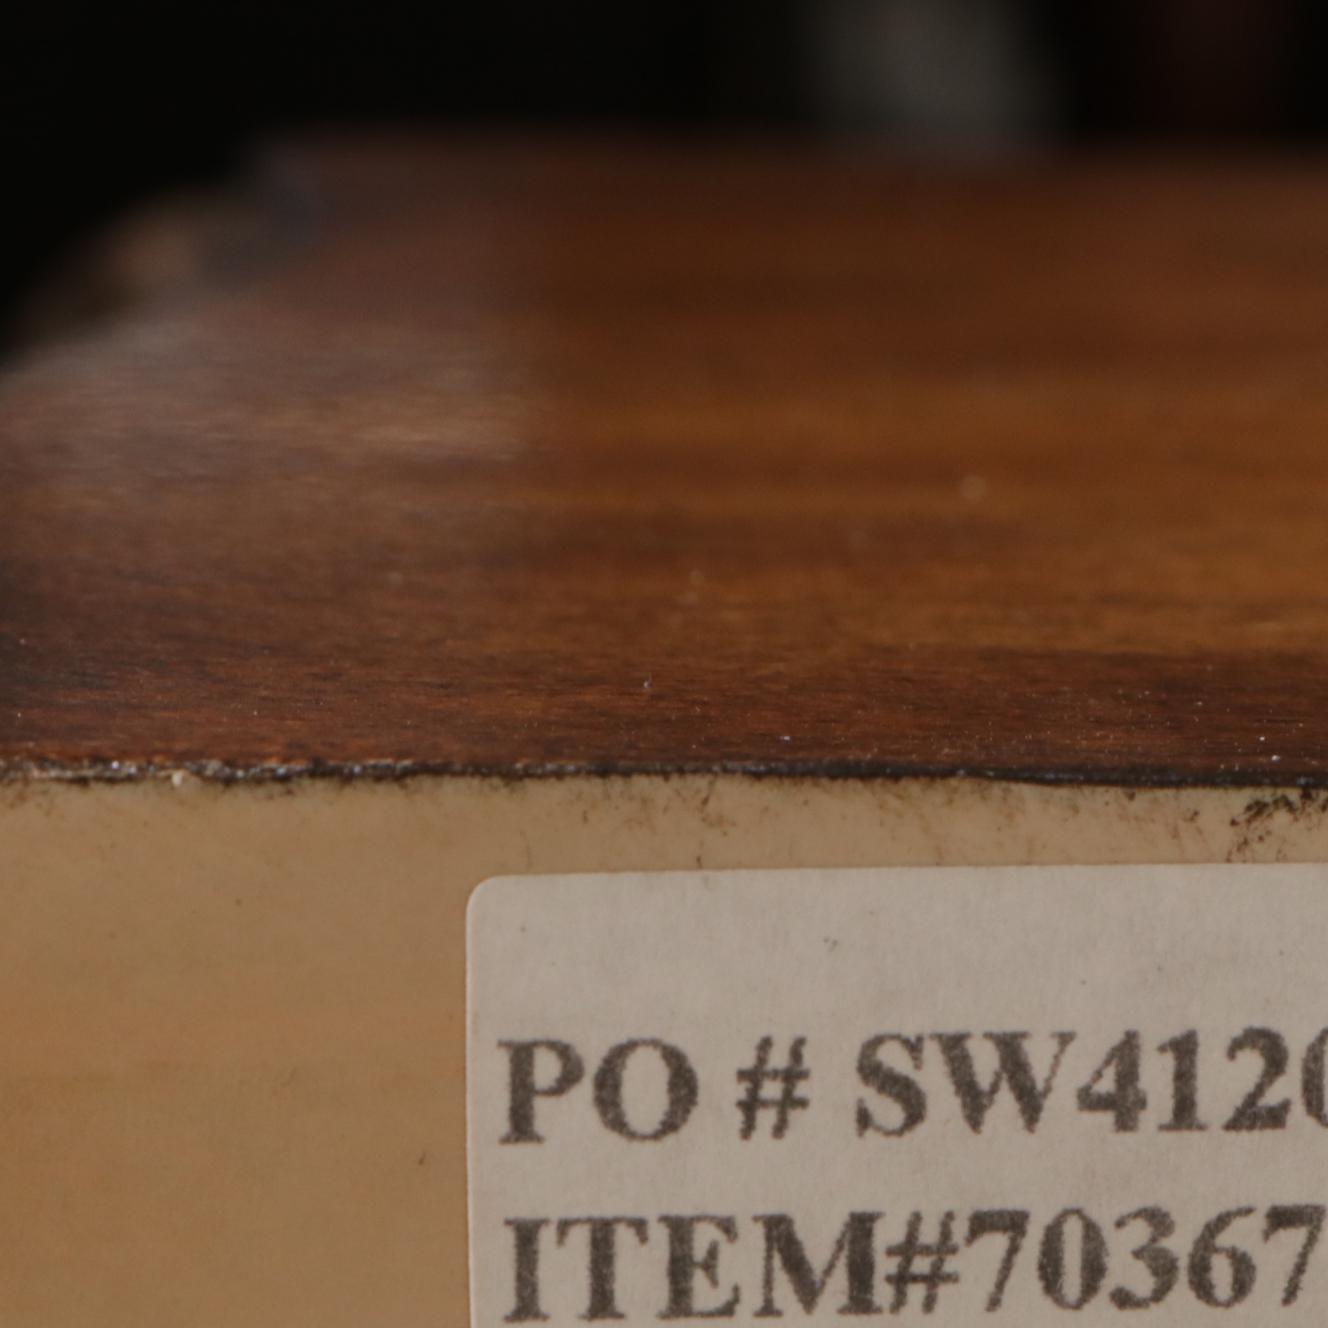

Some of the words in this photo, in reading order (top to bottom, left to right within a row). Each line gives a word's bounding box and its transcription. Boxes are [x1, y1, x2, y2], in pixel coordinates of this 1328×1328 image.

[497, 1037, 699, 1145] PO
[735, 1034, 811, 1141] #
[502, 1202, 1327, 1324] ITEM#70367
